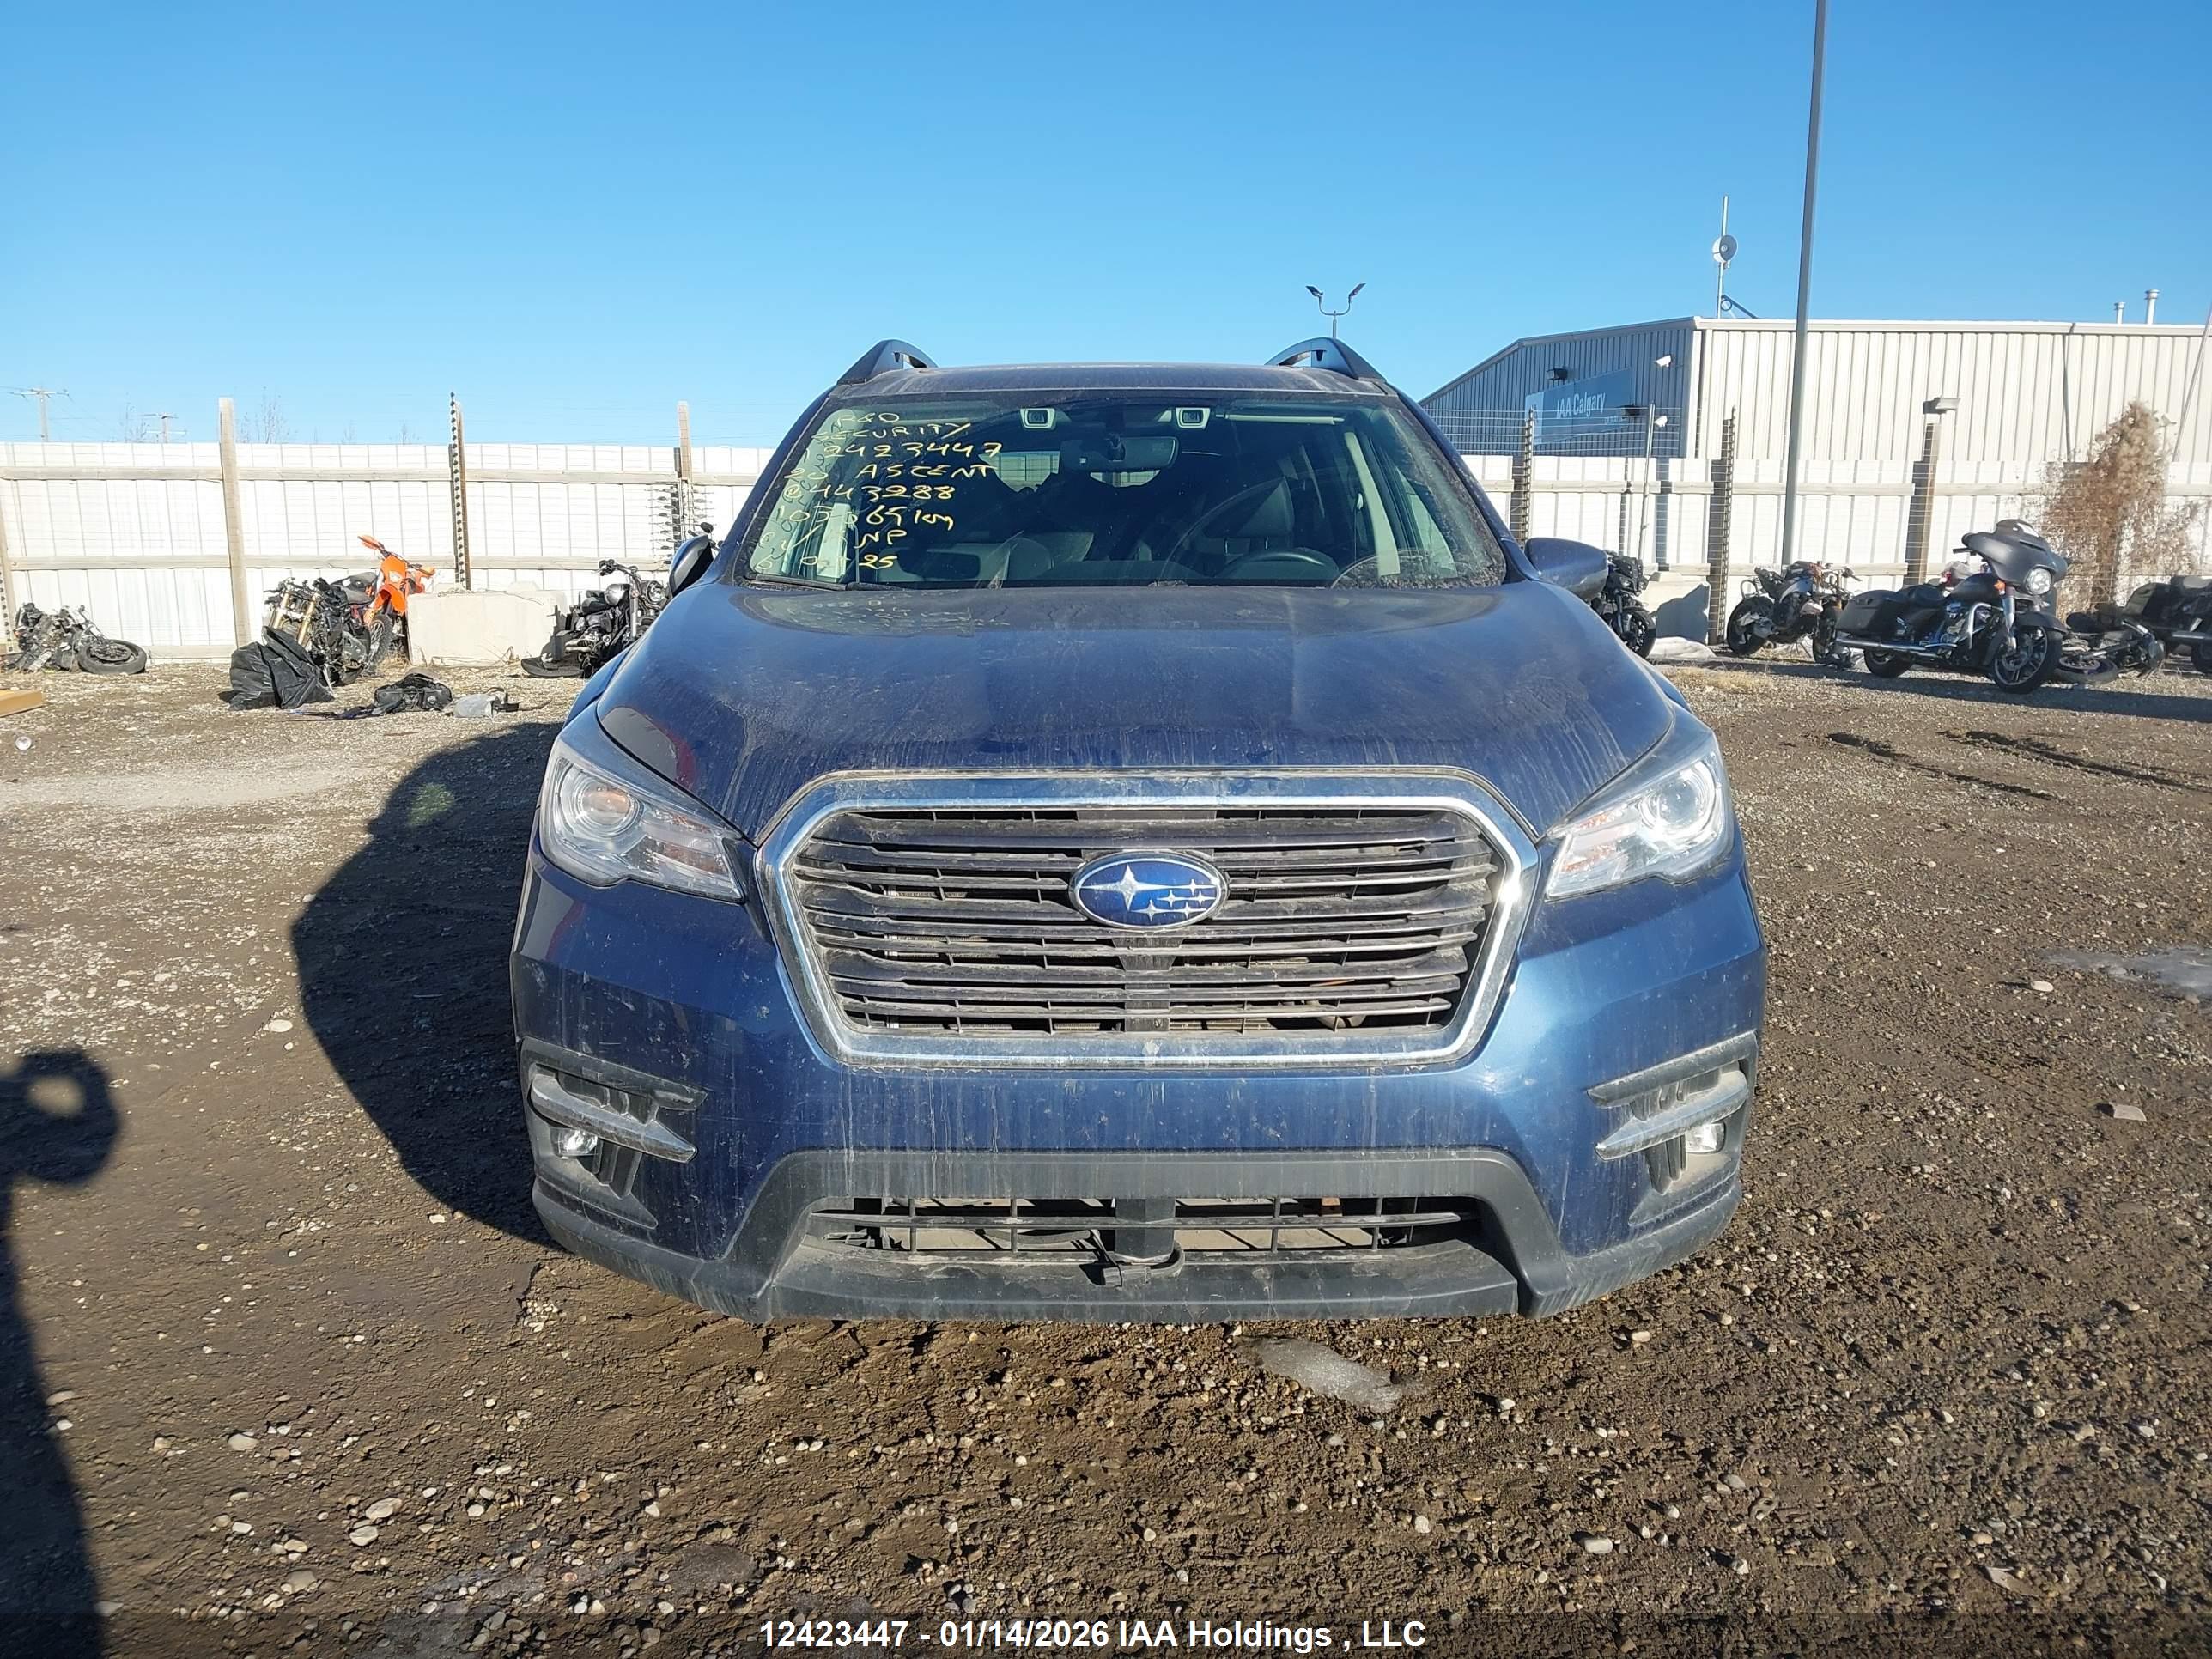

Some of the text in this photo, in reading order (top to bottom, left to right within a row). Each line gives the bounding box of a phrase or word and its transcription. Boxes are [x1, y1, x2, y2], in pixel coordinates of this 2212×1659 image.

[1556, 391, 1607, 419] IAA Calgary
[811, 422, 971, 441] SECURITY
[804, 441, 1004, 461] 12423447
[783, 463, 998, 481] 20 ASCENT
[858, 553, 898, 570] 25
